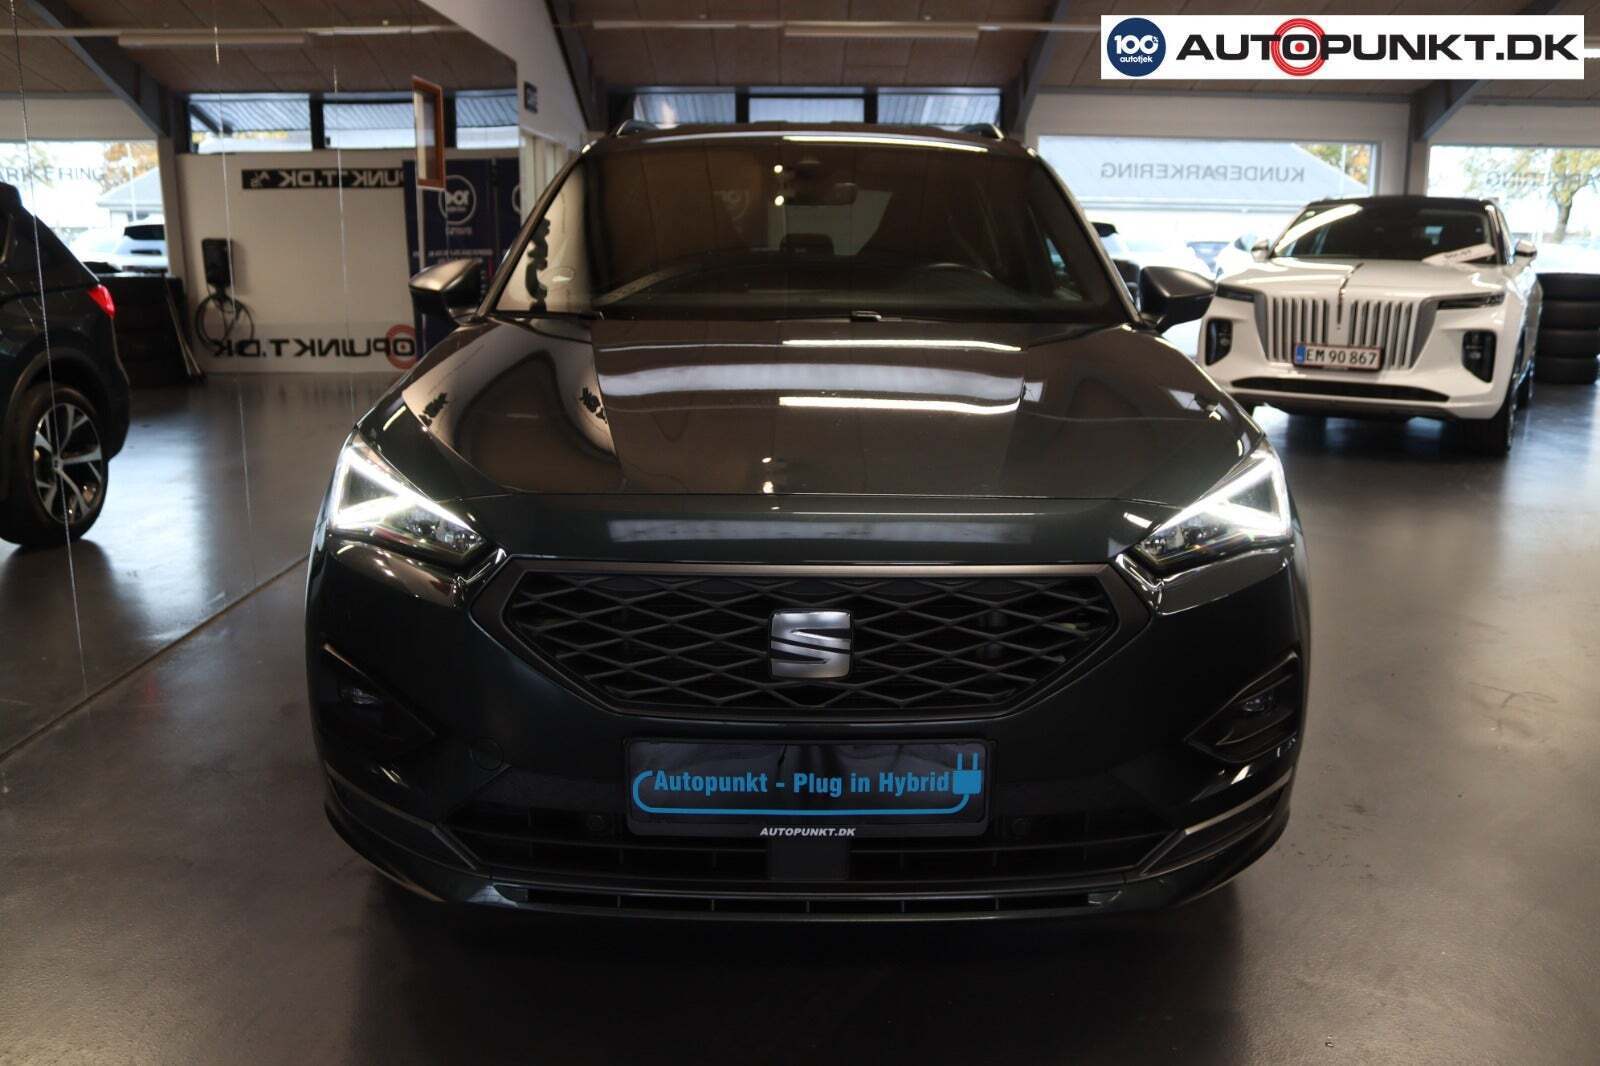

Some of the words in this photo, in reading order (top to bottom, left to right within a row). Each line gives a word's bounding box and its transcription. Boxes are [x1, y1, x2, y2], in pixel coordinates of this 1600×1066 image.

[1306, 348, 1325, 361] EM
[1329, 350, 1346, 364] 90
[1350, 351, 1377, 365] 867
[653, 770, 768, 796] Autopunkt
[793, 772, 842, 798] Plug
[850, 772, 870, 793] in
[879, 771, 949, 798] Hybrid
[759, 827, 856, 837] AUTOPUNKT.DK
